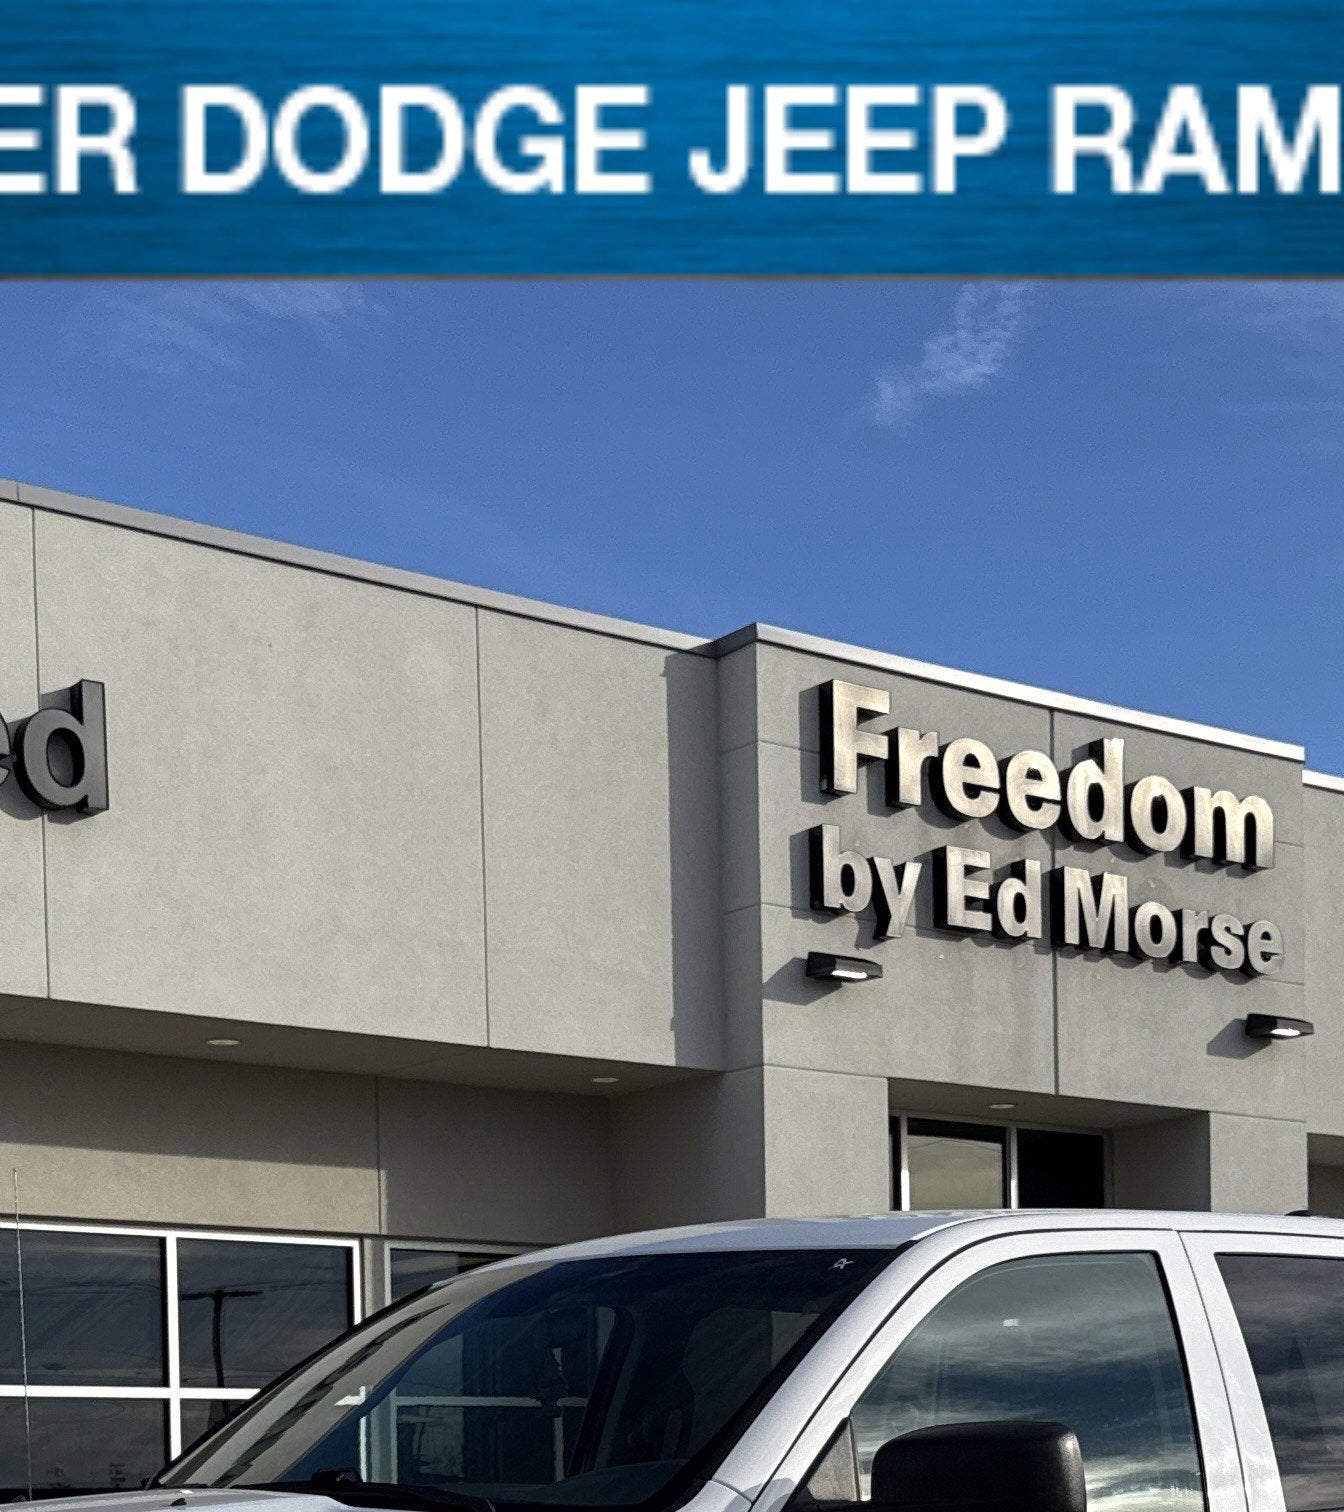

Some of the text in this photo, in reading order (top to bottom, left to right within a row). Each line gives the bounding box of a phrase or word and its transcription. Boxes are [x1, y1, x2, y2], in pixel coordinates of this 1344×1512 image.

[820, 679, 1275, 870] Freedom
[809, 824, 1285, 977] by Ed Morse
